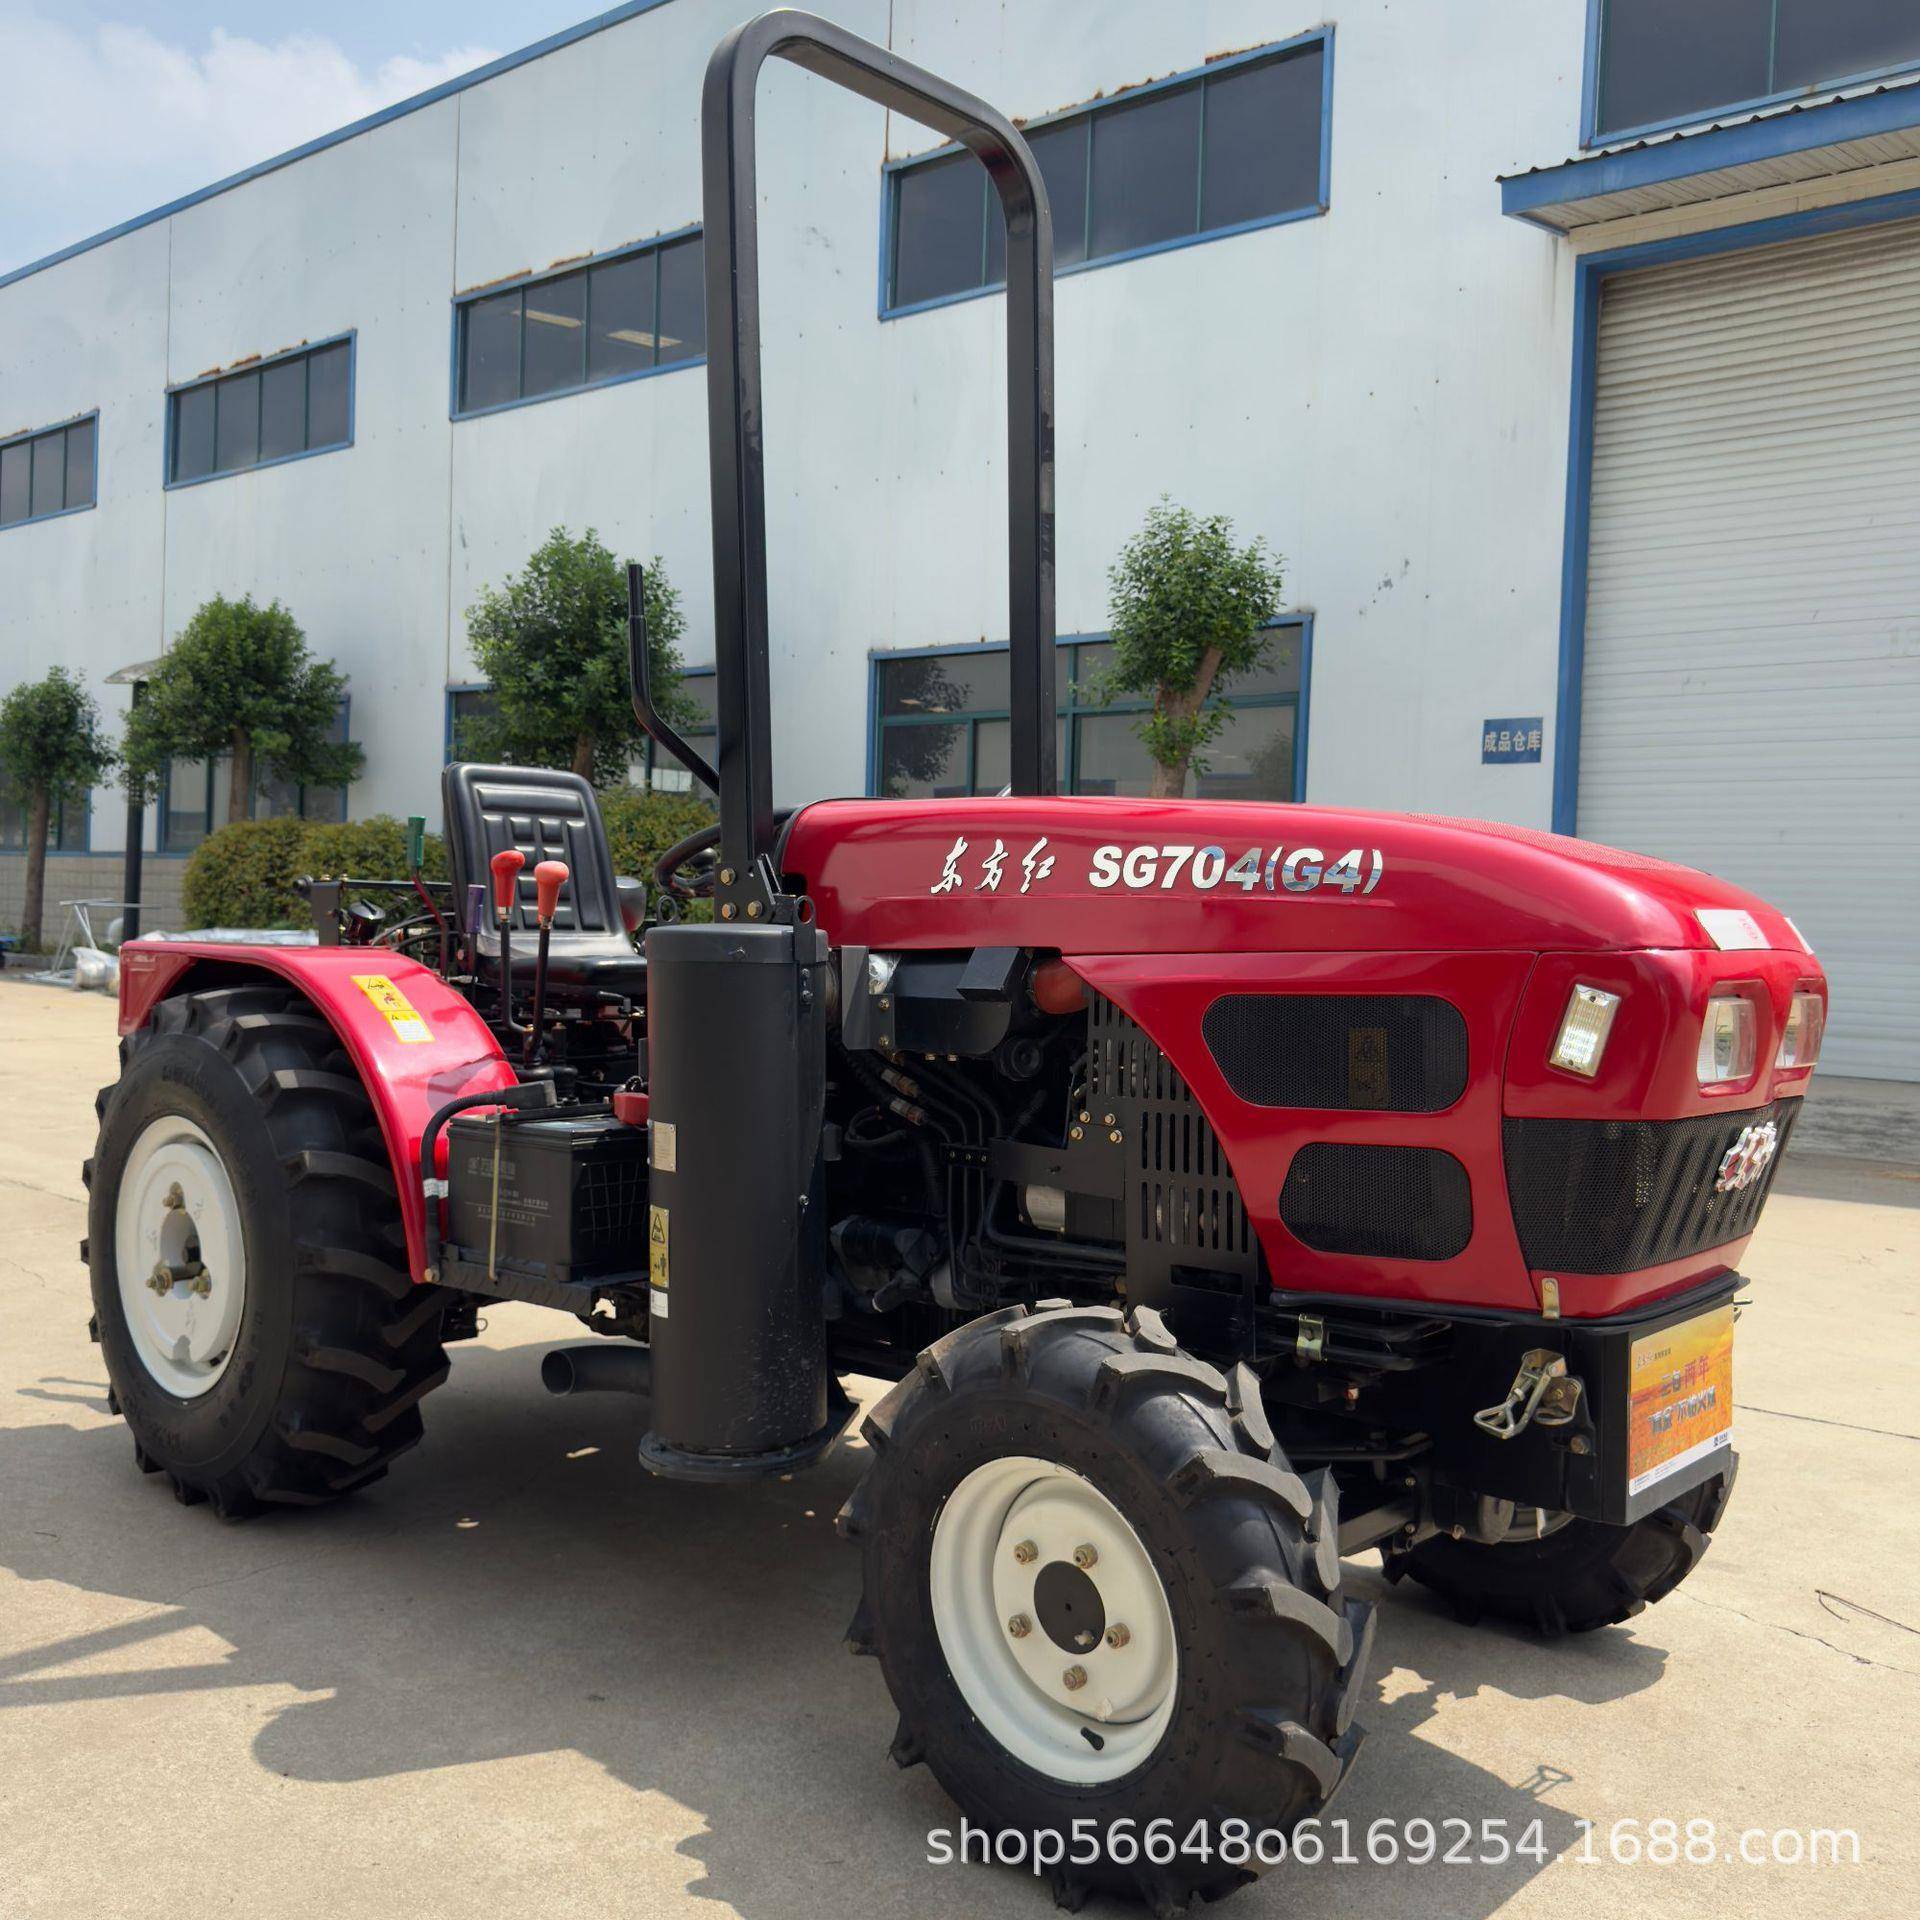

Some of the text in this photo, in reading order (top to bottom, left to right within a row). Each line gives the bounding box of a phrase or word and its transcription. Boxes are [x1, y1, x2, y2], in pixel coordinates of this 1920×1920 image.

[1484, 729, 1542, 753] 成品仓库
[930, 836, 1055, 895] 东方红
[1088, 845, 1384, 895] SG704(G4)
